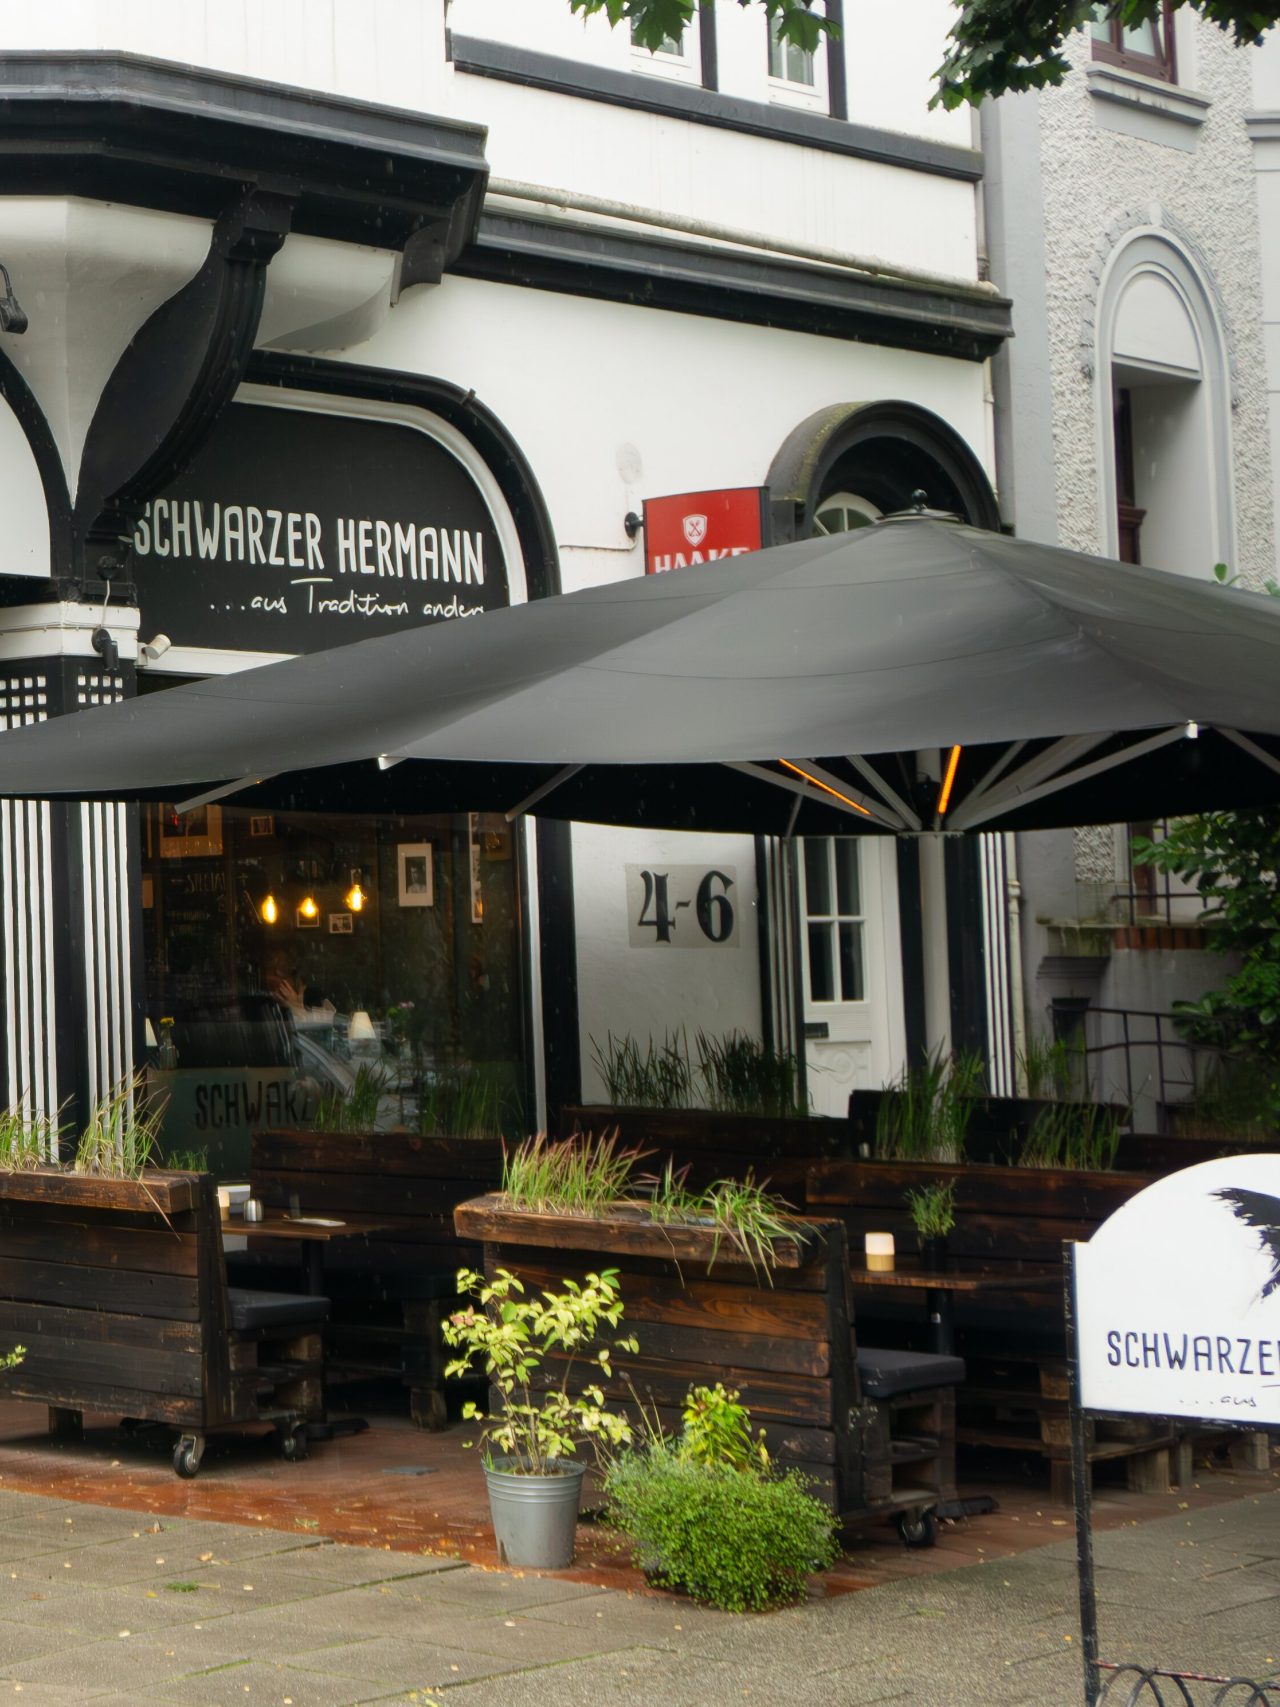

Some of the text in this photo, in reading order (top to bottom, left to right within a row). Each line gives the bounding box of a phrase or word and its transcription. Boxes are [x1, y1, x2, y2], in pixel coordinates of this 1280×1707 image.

[134, 499, 485, 585] SCHWARZER HERMANN
[291, 578, 408, 617] Tradition
[638, 870, 734, 944] 4-6
[1107, 1330, 1280, 1376] SCHWARZE
